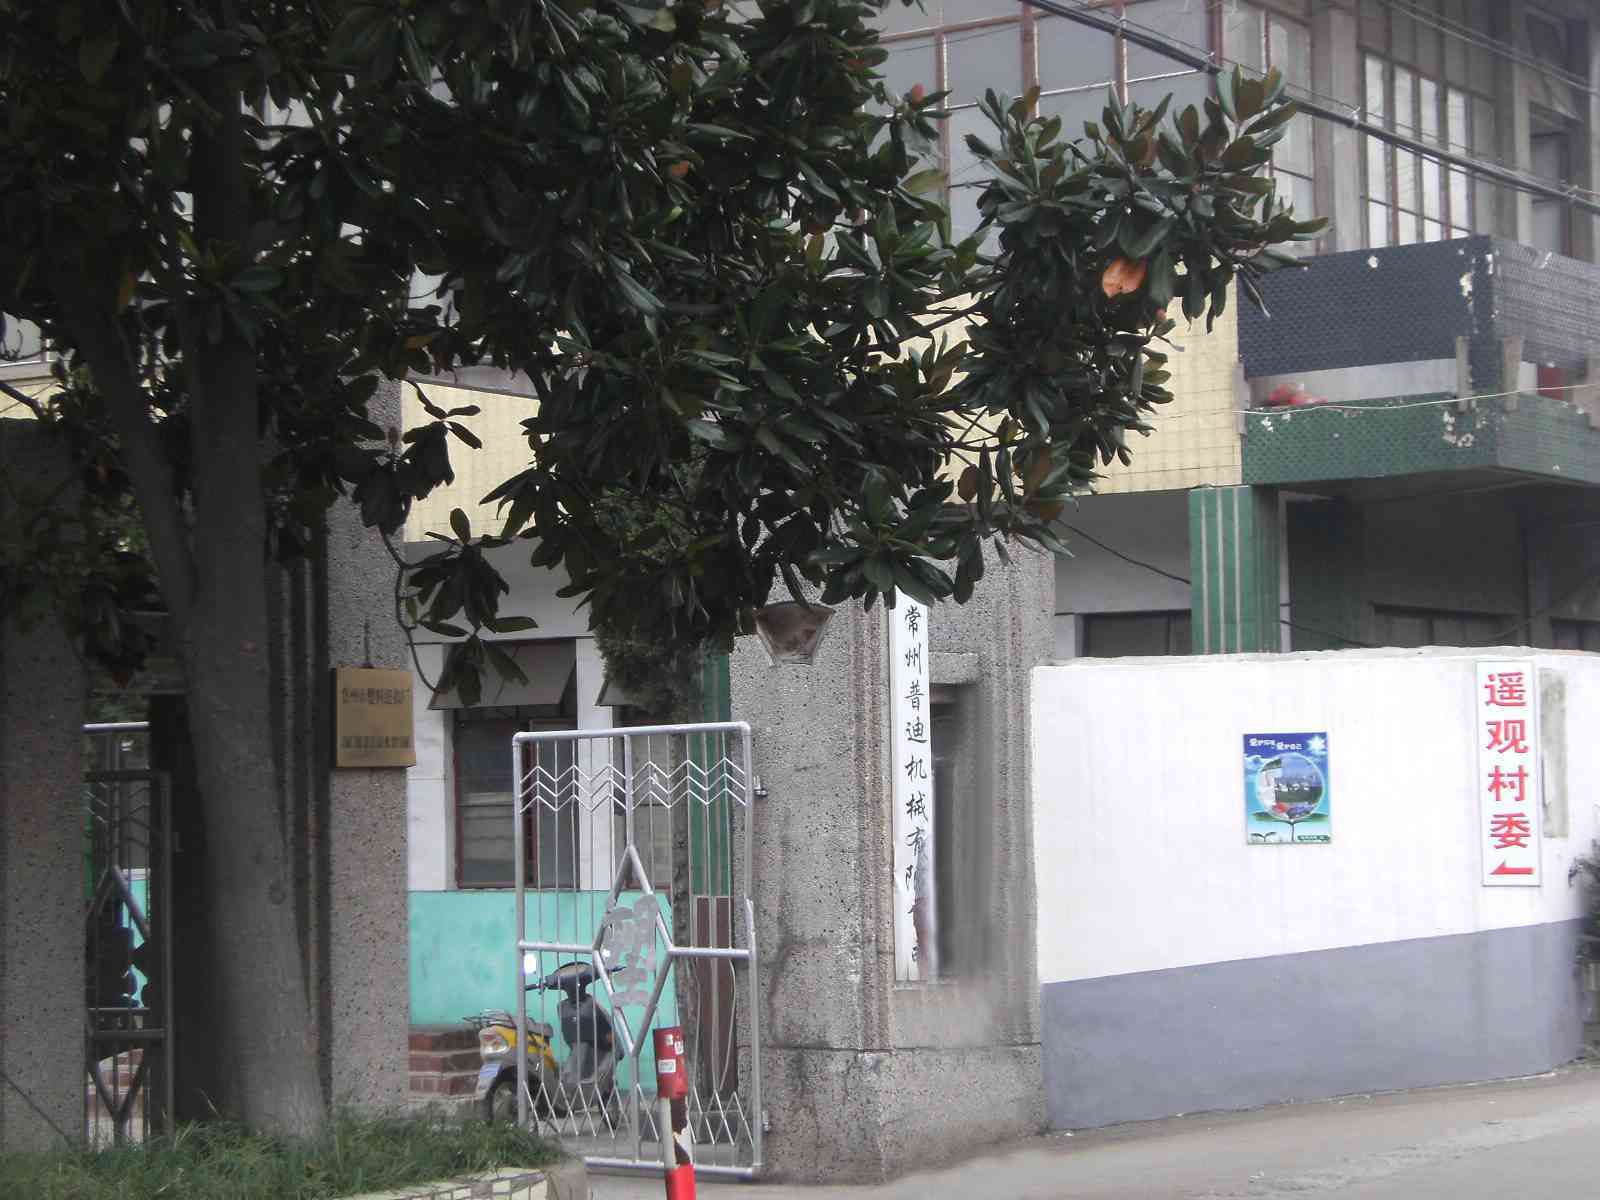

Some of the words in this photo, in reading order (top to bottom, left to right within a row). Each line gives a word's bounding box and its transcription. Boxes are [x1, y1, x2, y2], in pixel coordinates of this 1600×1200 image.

[904, 604, 929, 963] 常州普迪机械有
[1484, 671, 1531, 850] 遥观村委
